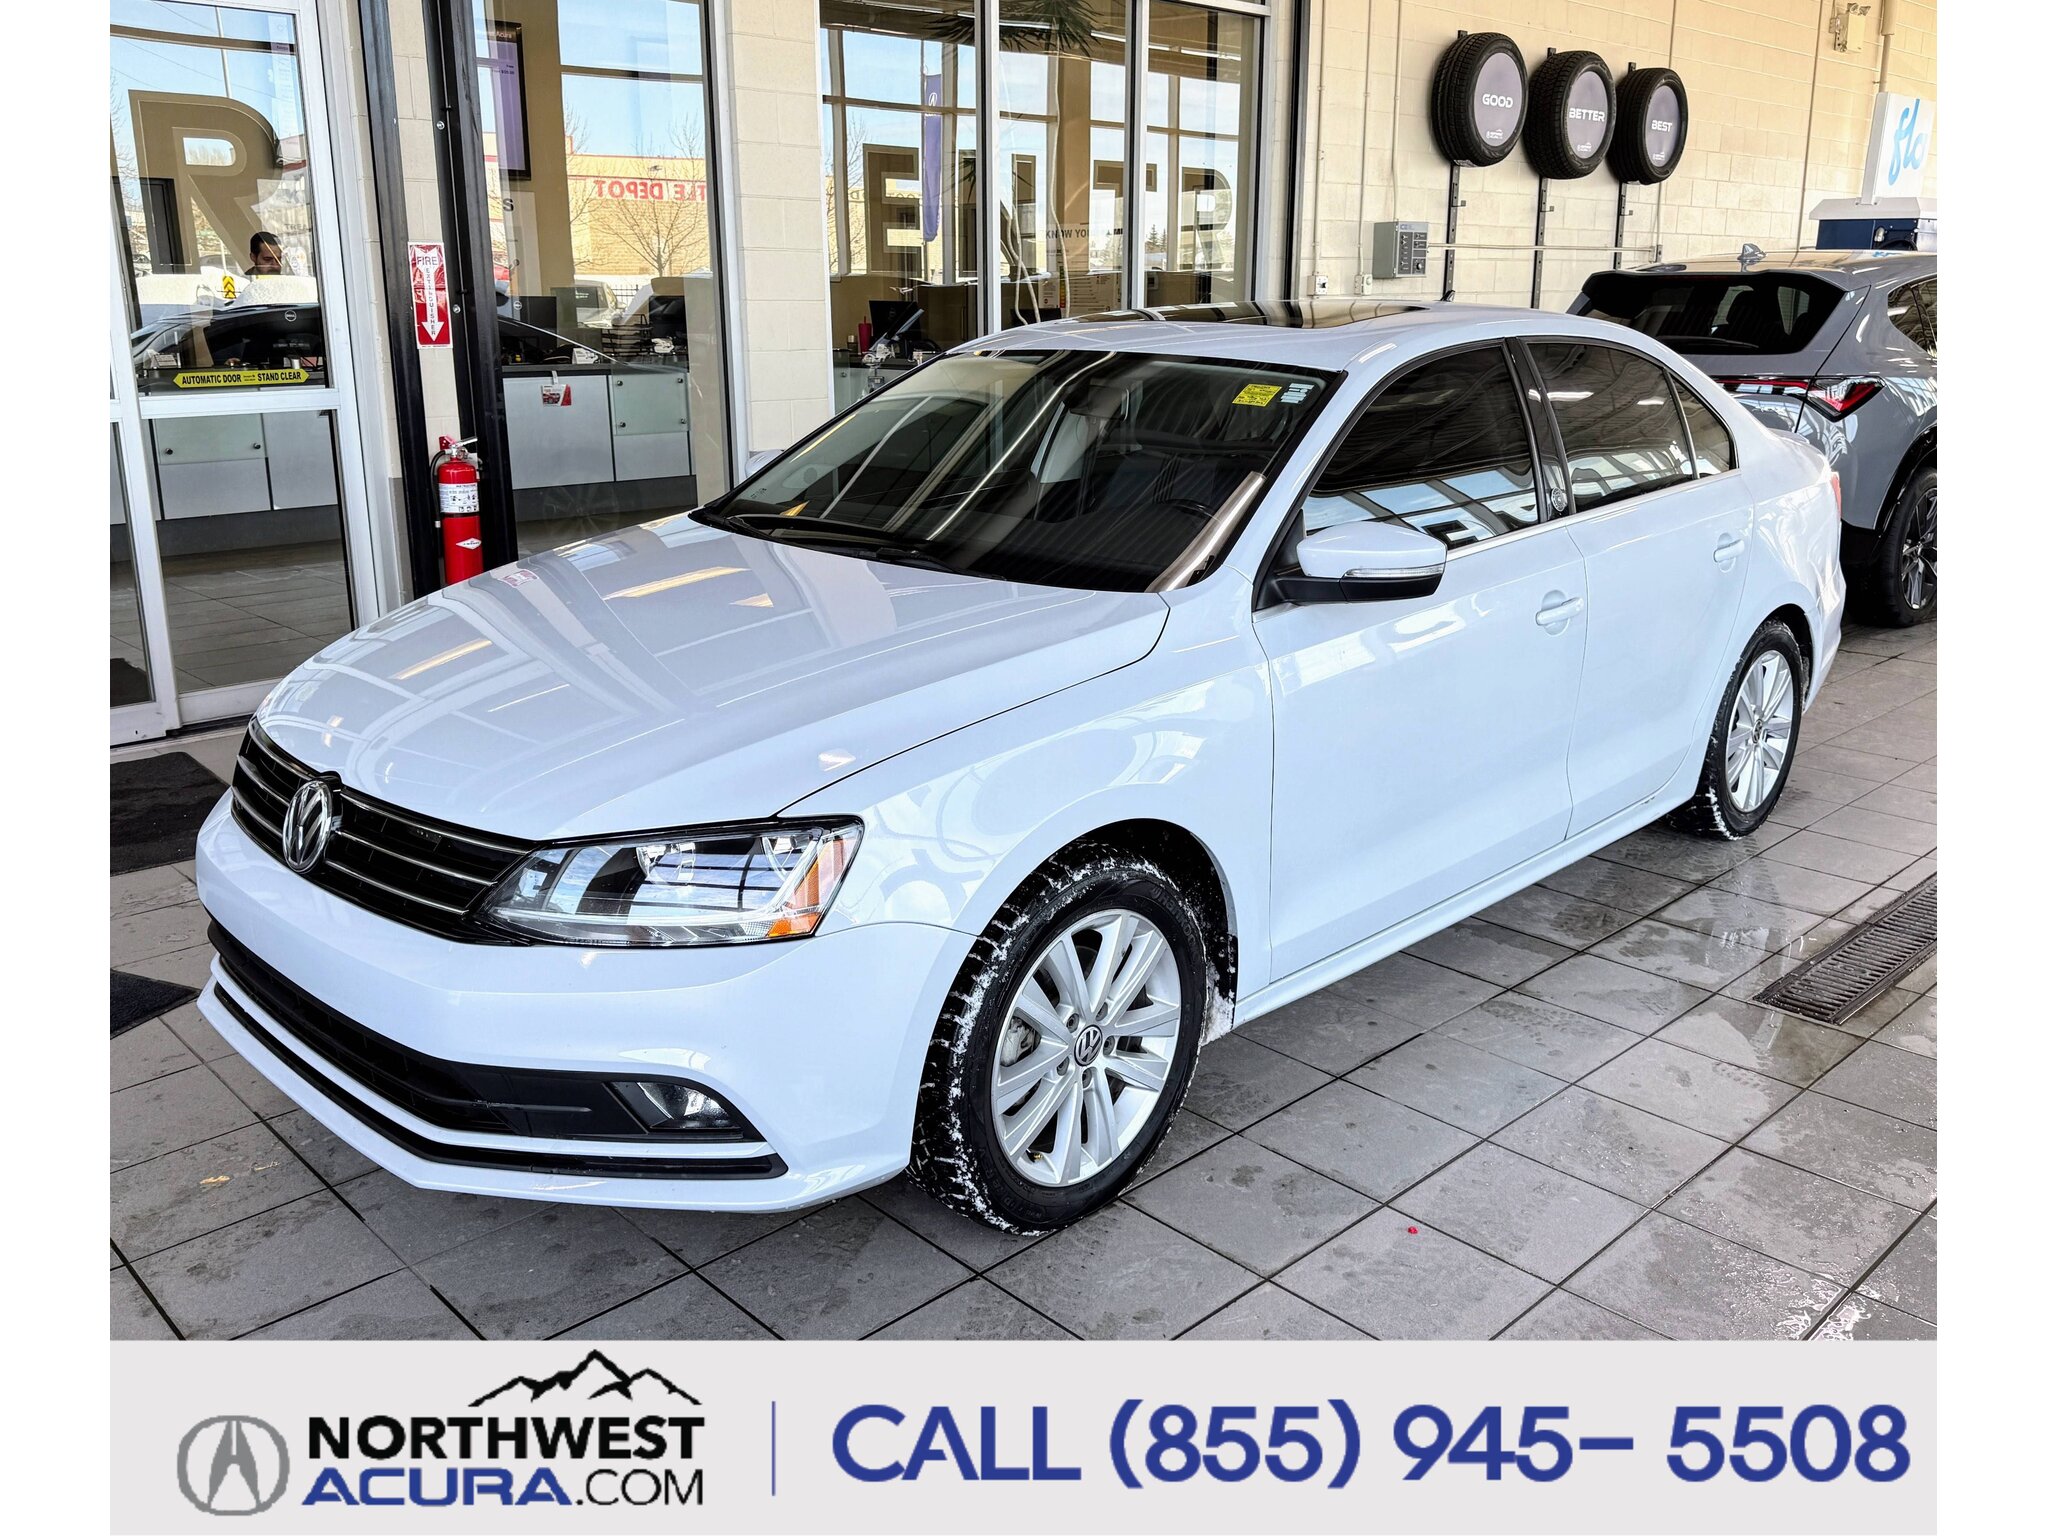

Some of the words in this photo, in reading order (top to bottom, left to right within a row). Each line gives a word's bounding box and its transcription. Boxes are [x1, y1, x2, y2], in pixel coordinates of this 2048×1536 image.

[1482, 93, 1513, 108] GOOD
[1568, 107, 1605, 122] BETTER
[1651, 119, 1673, 132] BEST
[417, 256, 438, 266] FIRE
[182, 374, 222, 385] AUTOMATIC
[223, 373, 242, 383] DOOR
[257, 372, 280, 382] STAND
[281, 371, 302, 381] CLEAR
